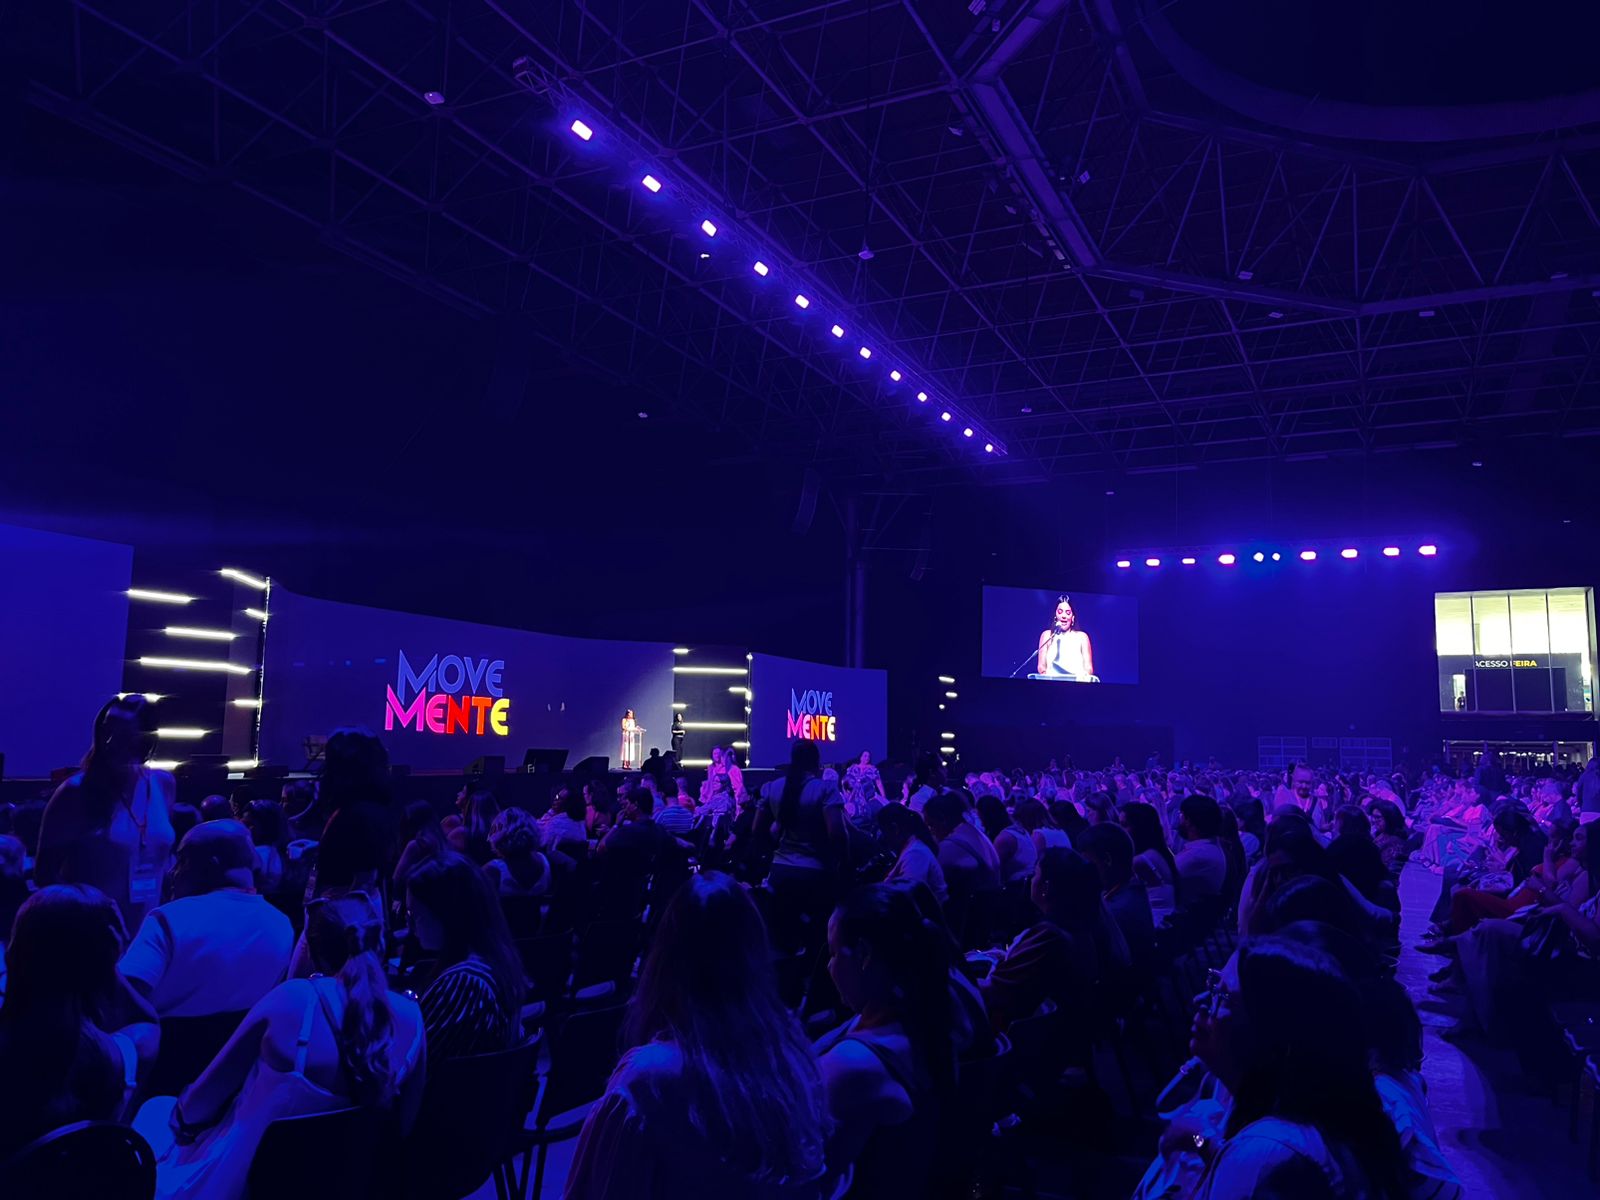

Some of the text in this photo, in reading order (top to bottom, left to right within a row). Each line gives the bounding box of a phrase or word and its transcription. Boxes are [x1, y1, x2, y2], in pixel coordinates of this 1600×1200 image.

[397, 649, 504, 705] MOVE
[385, 684, 511, 736] MENTE
[786, 709, 837, 741] MENTE
[791, 687, 833, 721] MOVE
